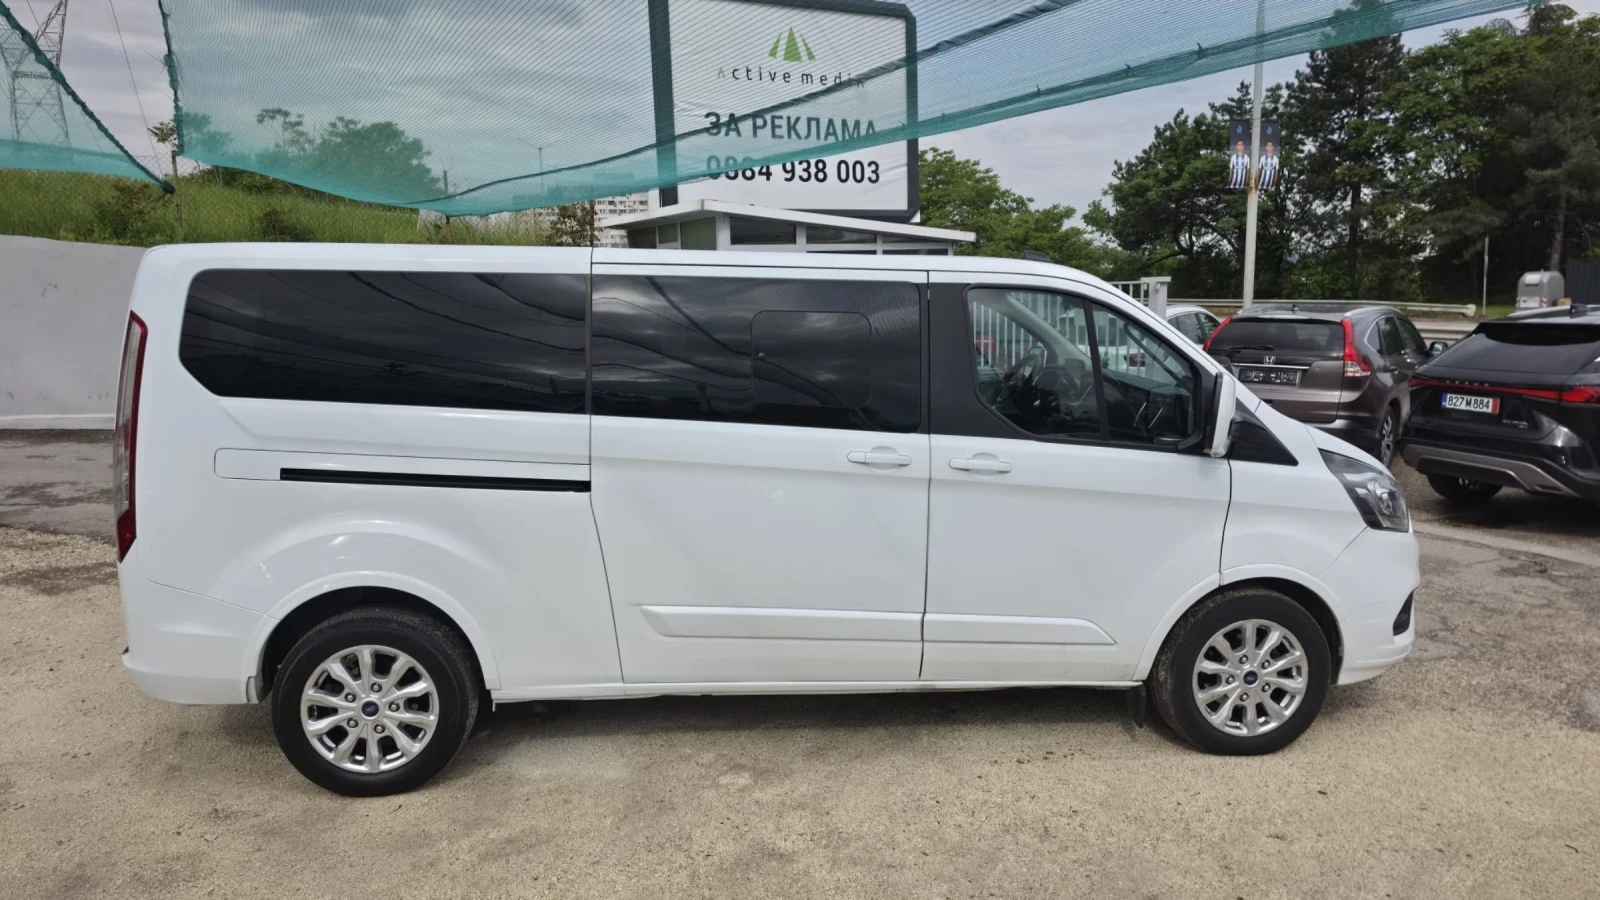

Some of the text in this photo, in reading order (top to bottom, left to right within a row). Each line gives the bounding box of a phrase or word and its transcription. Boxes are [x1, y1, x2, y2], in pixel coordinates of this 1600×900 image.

[704, 112, 742, 137] ЗА
[781, 159, 828, 183] 938
[836, 160, 880, 184] 003
